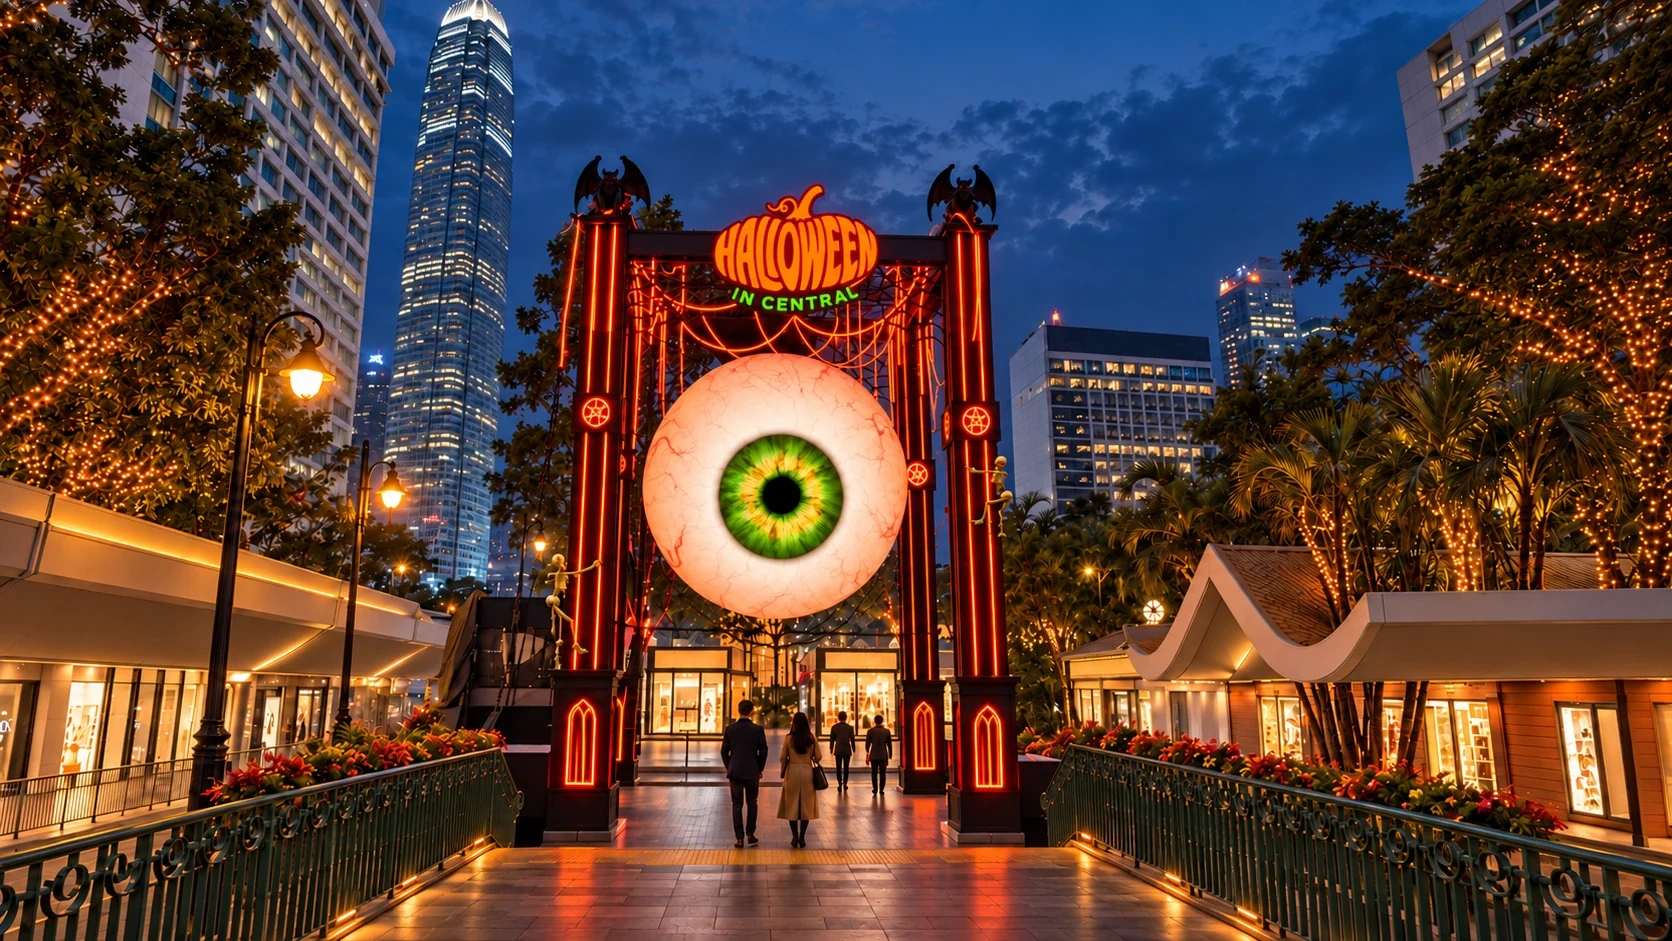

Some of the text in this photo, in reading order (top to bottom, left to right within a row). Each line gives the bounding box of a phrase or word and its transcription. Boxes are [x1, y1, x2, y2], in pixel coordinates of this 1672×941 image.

[714, 215, 878, 291] HALLOWEEN
[731, 287, 859, 312] IN CENTRAL
